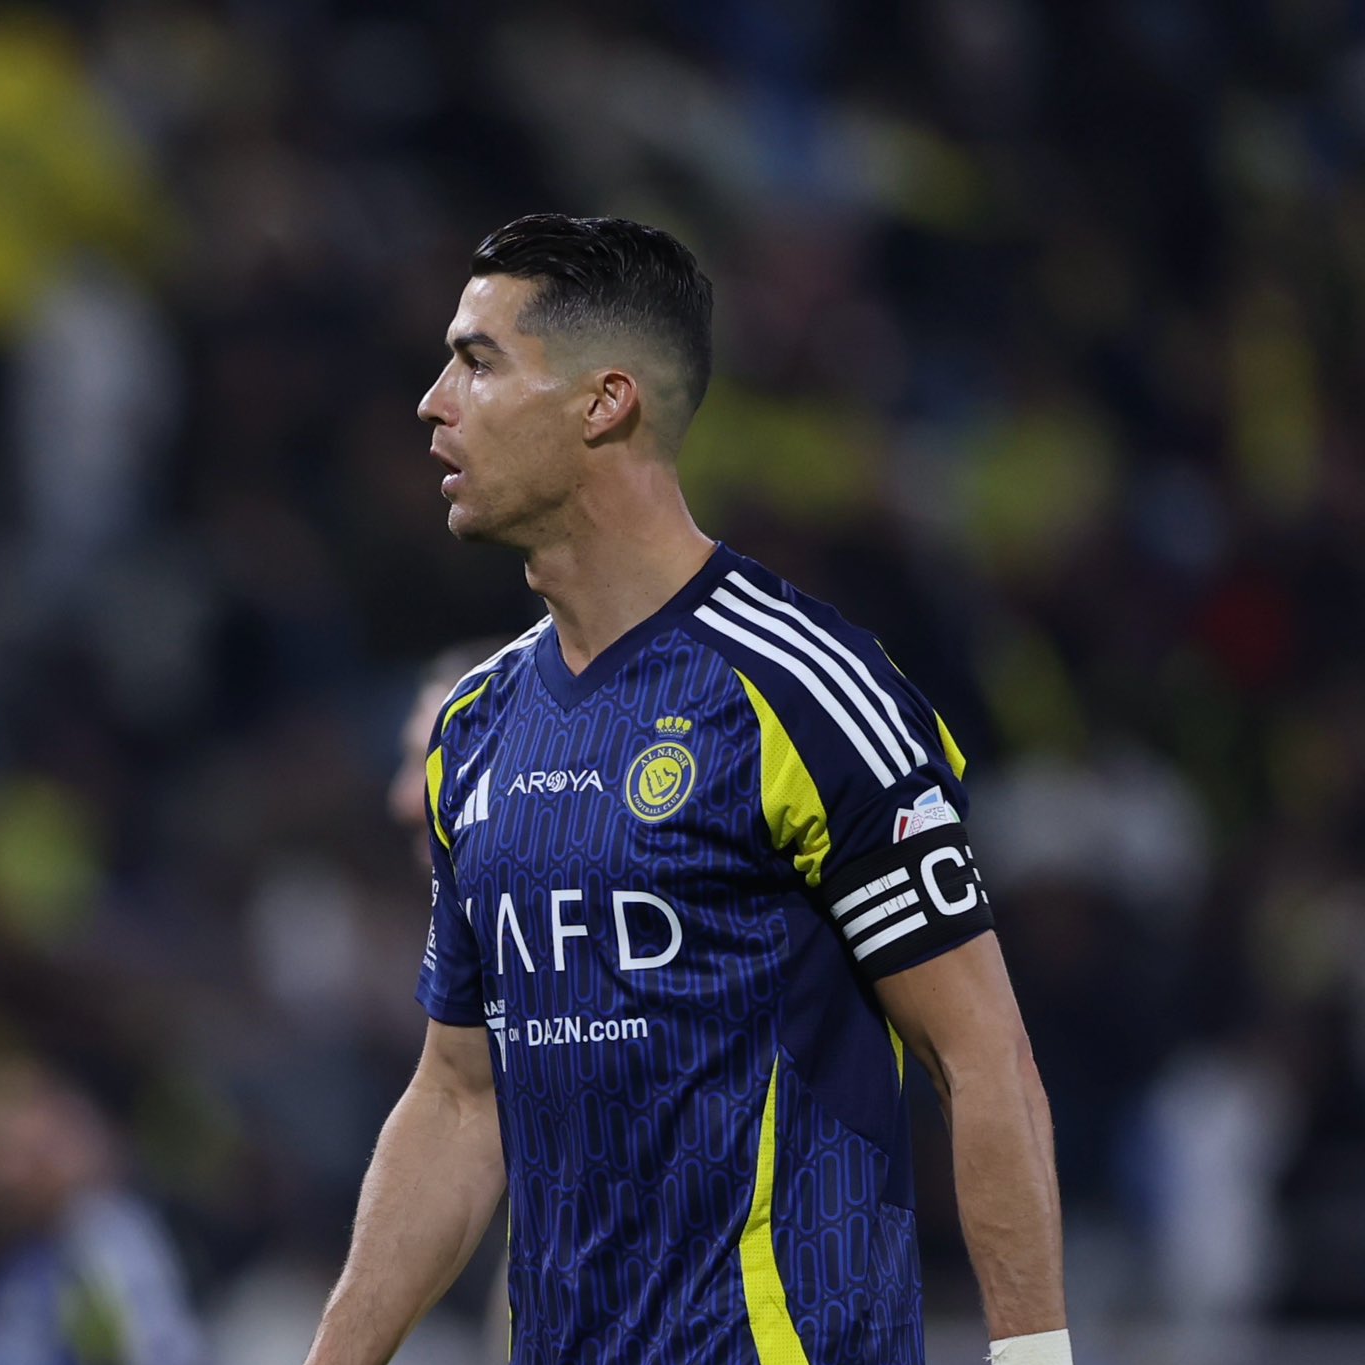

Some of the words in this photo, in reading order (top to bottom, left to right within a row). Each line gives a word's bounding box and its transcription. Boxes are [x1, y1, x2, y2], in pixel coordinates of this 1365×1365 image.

[640, 753, 656, 768] AL
[657, 748, 689, 769] NASSR
[507, 770, 604, 796] AROYA
[662, 793, 681, 811] CLUB
[509, 1027, 520, 1042] ON
[527, 1016, 648, 1046] DAZN.com
